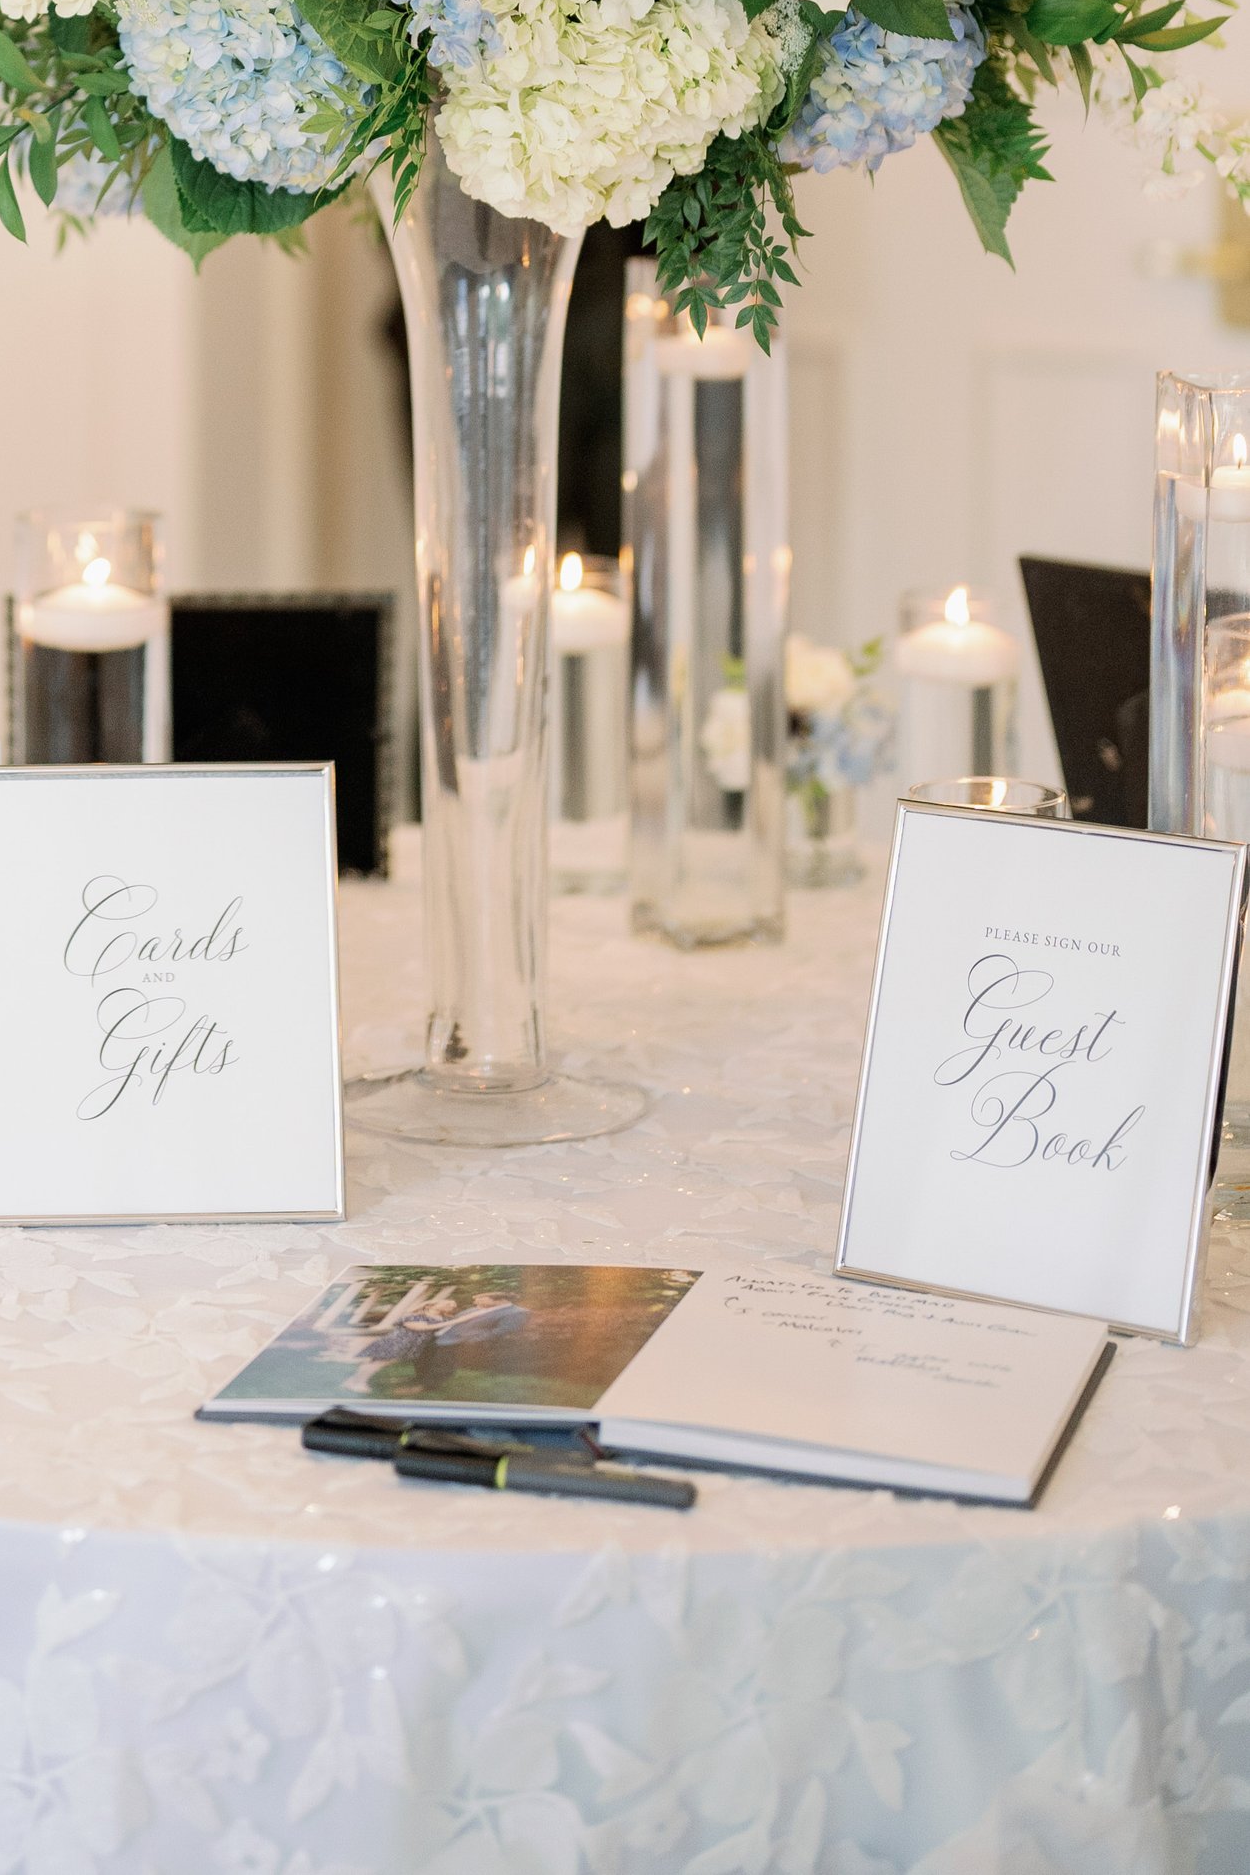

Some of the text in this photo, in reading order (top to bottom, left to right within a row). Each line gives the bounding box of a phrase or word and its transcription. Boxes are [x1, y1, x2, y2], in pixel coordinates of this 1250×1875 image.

[63, 874, 250, 988] Cards
[141, 972, 176, 983] AND
[984, 926, 1122, 957] PLEASE SIGN OUR
[76, 987, 240, 1121] Gifts
[933, 953, 1126, 1086] Guest
[949, 1060, 1146, 1172] Book
